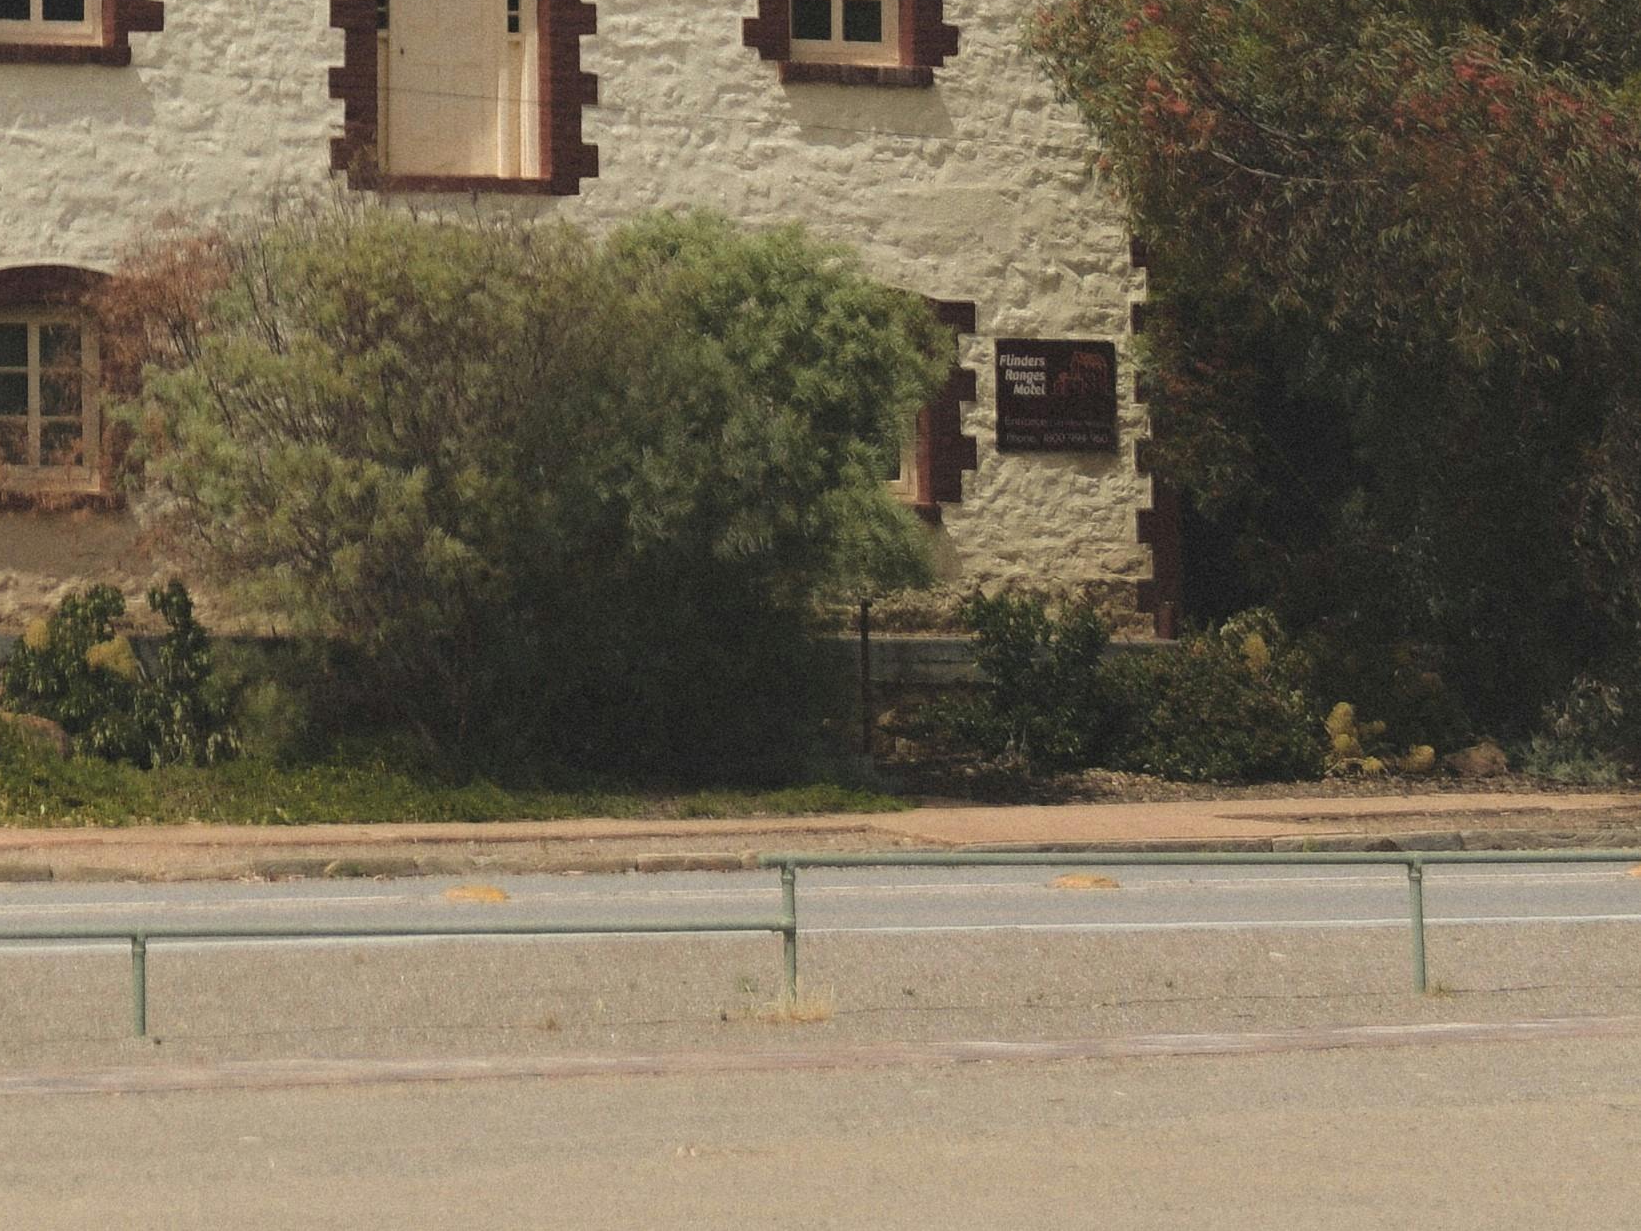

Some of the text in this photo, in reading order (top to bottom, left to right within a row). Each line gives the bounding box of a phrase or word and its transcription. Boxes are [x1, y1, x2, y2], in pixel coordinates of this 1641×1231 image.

[999, 354, 1045, 366] Flinders
[1005, 369, 1046, 384] Ranges
[1014, 382, 1046, 395] Motel
